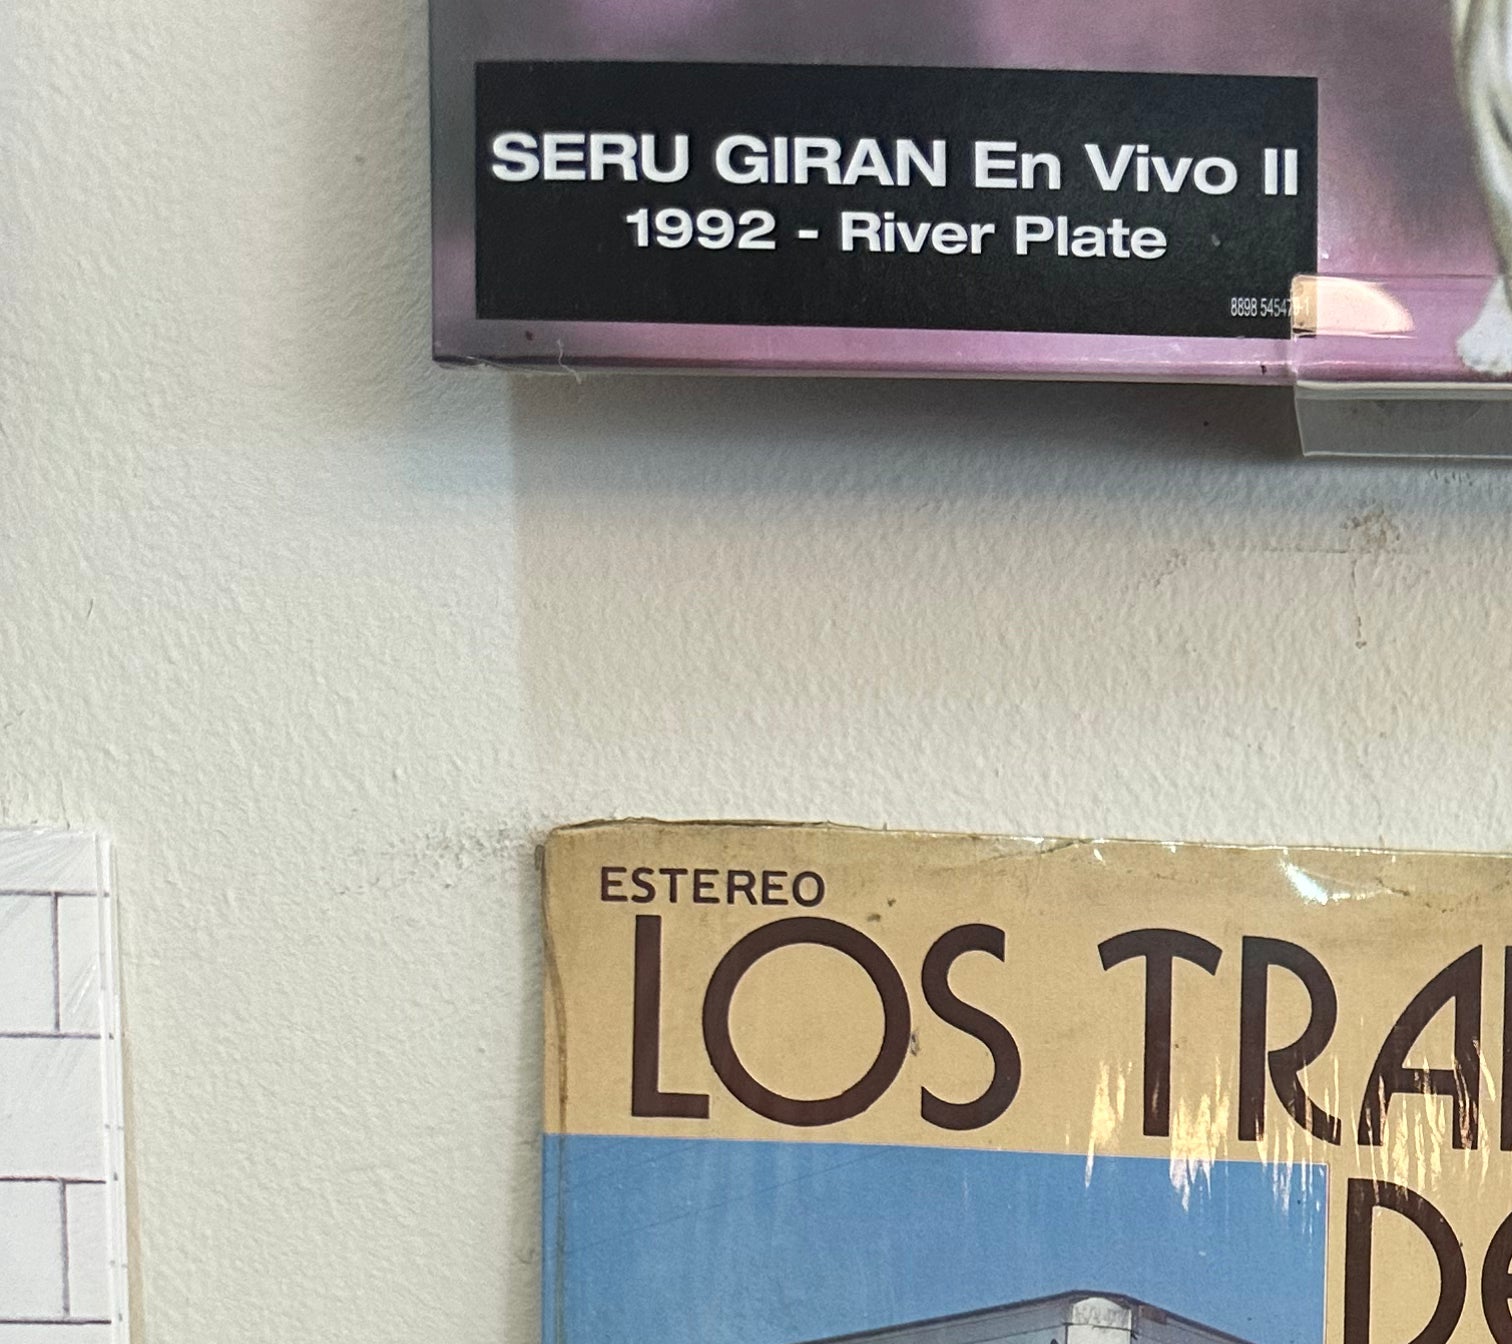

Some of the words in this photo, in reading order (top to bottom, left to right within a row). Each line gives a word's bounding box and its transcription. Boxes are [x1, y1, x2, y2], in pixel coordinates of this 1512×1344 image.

[492, 132, 689, 183] SERU
[715, 134, 947, 188] GIRAN
[974, 140, 1061, 190] En
[1084, 143, 1239, 195] Vivo
[1263, 147, 1298, 196] II
[625, 207, 777, 250] 1992
[798, 229, 819, 239] -
[841, 211, 995, 254] River
[1015, 215, 1168, 260] Plate
[1230, 297, 1258, 317] 8898
[600, 866, 826, 907] ESTEREO
[631, 914, 1022, 1131] LOS
